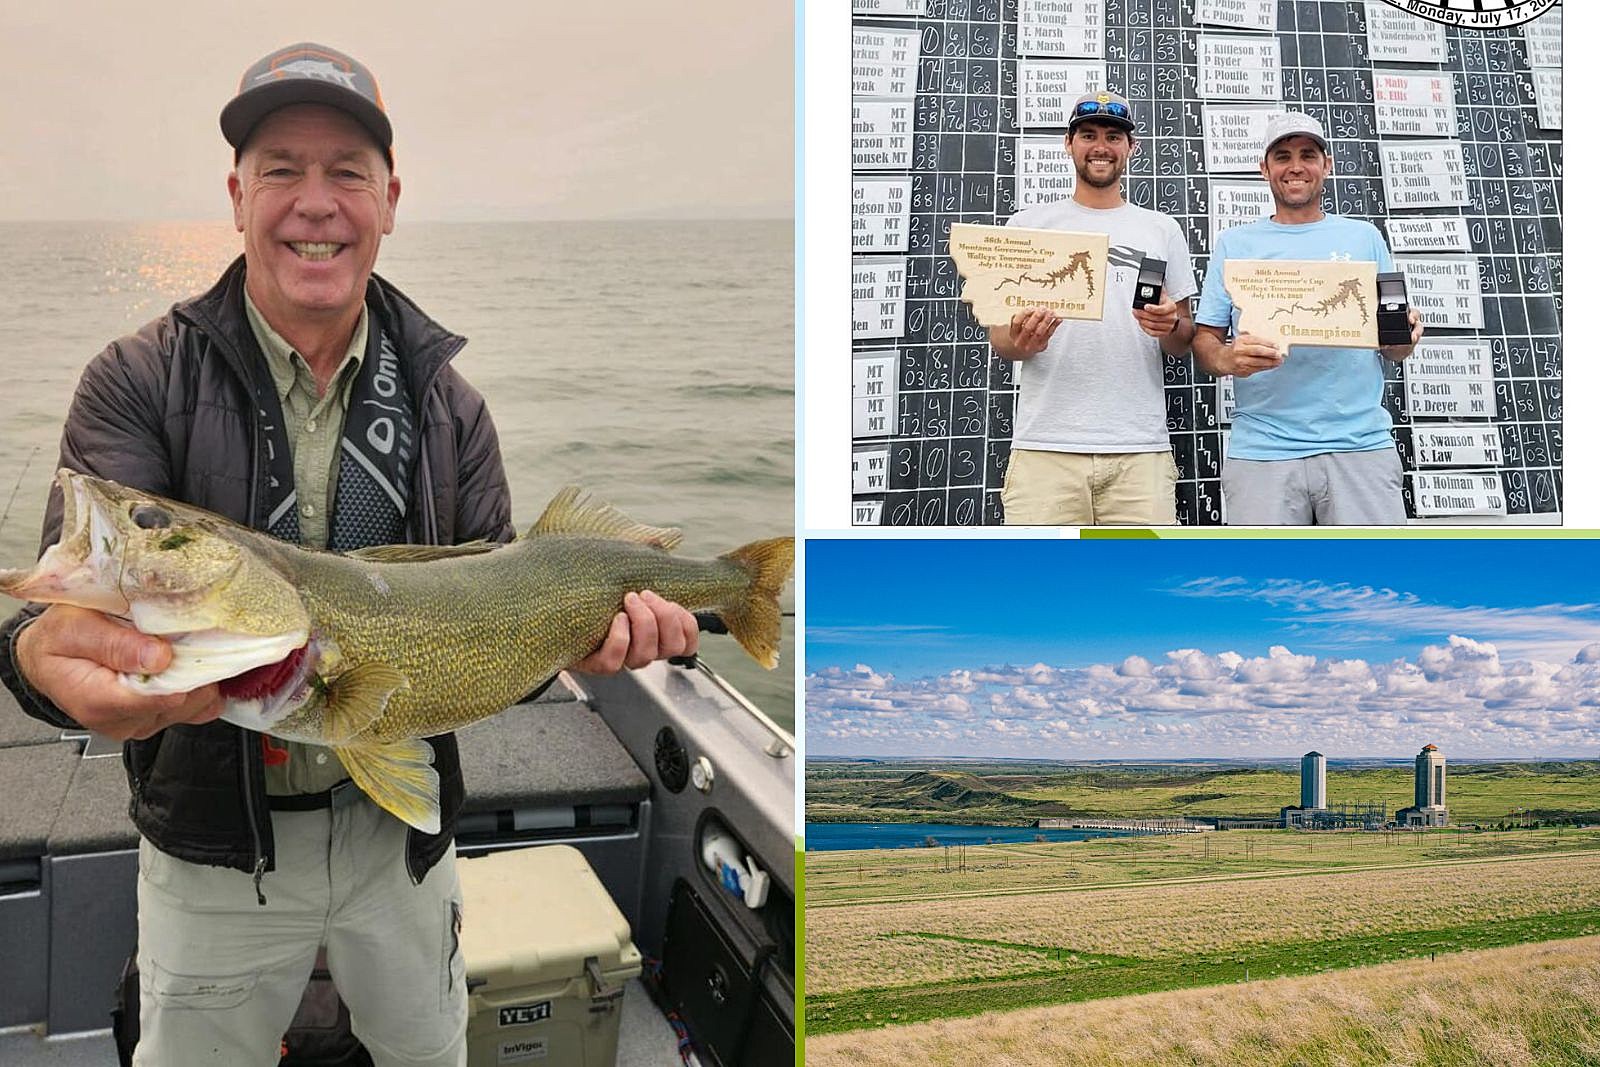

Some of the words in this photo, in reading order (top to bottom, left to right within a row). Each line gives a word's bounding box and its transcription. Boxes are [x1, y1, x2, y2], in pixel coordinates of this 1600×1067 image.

[1085, 4, 1098, 14] MT
[1085, 15, 1098, 25] MT
[1035, 27, 1063, 38] Marsh
[1084, 29, 1098, 39] MT
[1036, 40, 1065, 52] Marsh
[1083, 42, 1097, 53] MT
[1260, 46, 1273, 56] MT
[1261, 57, 1274, 68] MT
[891, 67, 906, 78] MT
[1086, 71, 1100, 81] MT
[1262, 72, 1275, 82] MT
[890, 81, 905, 93] MT
[1085, 83, 1099, 93] MT
[1261, 84, 1275, 95] MT
[1036, 96, 1061, 108] Stahl
[891, 108, 906, 118] MT
[1039, 111, 1063, 122] Stahl
[1433, 108, 1447, 118] WY
[891, 121, 906, 132] MT
[1392, 120, 1421, 131] Martin
[1436, 122, 1449, 132] WY
[1222, 127, 1248, 138] Fuchs
[890, 137, 904, 148] MT
[892, 151, 907, 163] MT
[1443, 149, 1456, 160] MT
[1036, 162, 1069, 174] Peters
[1401, 163, 1424, 173] Bork
[1404, 177, 1431, 187] Smith
[888, 187, 902, 199] ND
[1405, 191, 1440, 203] Hallock
[888, 203, 902, 213] ND
[884, 218, 899, 229] MT
[1443, 221, 1457, 232] MT
[884, 234, 900, 246] MT
[1404, 235, 1446, 247] Sorensen
[1446, 235, 1461, 246] MT
[1454, 264, 1468, 275] MT
[888, 271, 903, 282] MT
[1411, 278, 1434, 290] Mury
[1457, 279, 1471, 290] MT
[885, 286, 901, 298] MT
[1004, 295, 1086, 312] Champion
[1412, 296, 1445, 308] Wilcox
[1456, 297, 1470, 308] MT
[880, 303, 896, 315] MT
[881, 319, 894, 330] MT
[1458, 313, 1472, 324] MT
[1280, 324, 1361, 339] Champion
[1422, 349, 1453, 360] Cowen
[1468, 349, 1481, 360] MT
[867, 365, 884, 379] MT
[1420, 363, 1467, 375] Amundsen
[1469, 364, 1480, 374] MT
[867, 381, 883, 395] MT
[1423, 383, 1451, 394] Barth
[1469, 384, 1483, 395] MN
[868, 399, 885, 413] MT
[1425, 400, 1458, 412] Dreyer
[1471, 400, 1484, 412] MN
[868, 417, 885, 431] MT
[1430, 434, 1474, 447] Swanson
[1483, 434, 1497, 446] MT
[1432, 450, 1453, 462] Law
[1485, 449, 1499, 462] MT
[868, 458, 885, 470] WY
[868, 475, 884, 487] WY
[1434, 477, 1474, 489] Holman
[1482, 477, 1496, 490] ND
[1434, 496, 1475, 509] Holman
[1487, 496, 1501, 509] ND
[856, 508, 875, 522] WY
[502, 1004, 548, 1023] YETI
